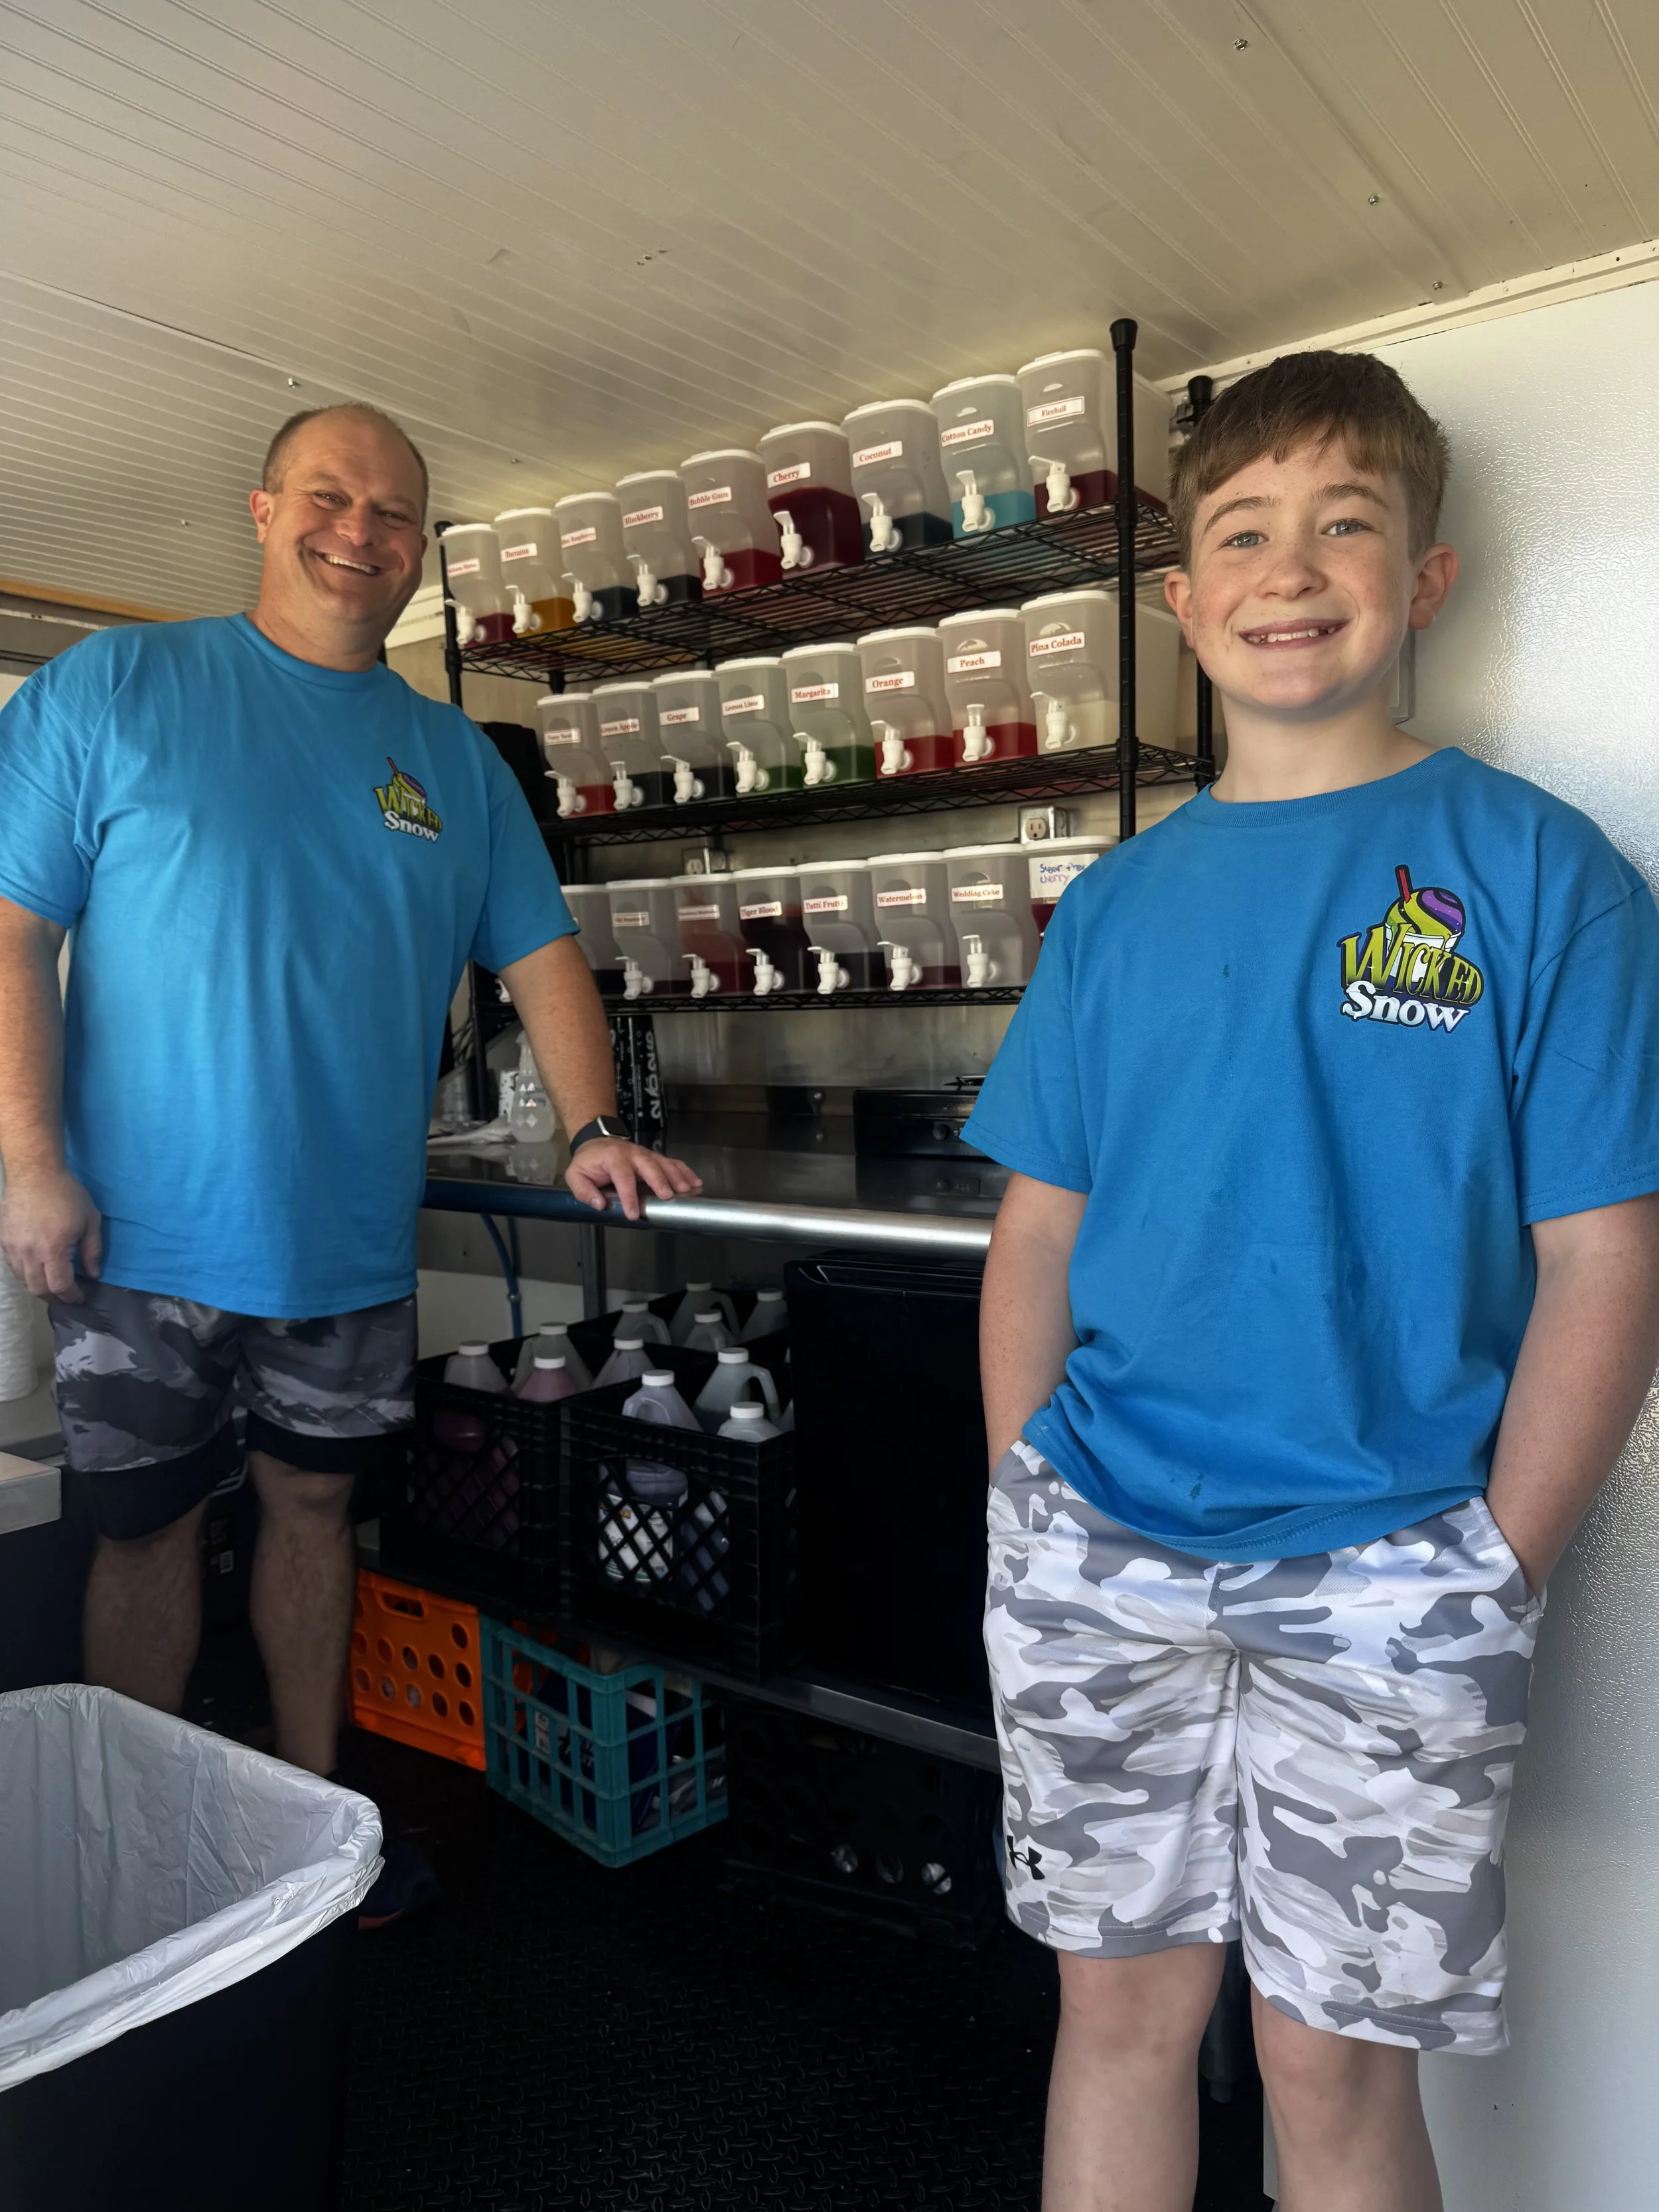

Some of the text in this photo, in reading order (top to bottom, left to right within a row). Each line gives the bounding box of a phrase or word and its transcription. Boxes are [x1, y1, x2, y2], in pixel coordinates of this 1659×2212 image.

[942, 424, 992, 443] Cotton Candy
[859, 448, 892, 463] Coconut
[772, 469, 800, 483] Cherry
[689, 491, 729, 506] Bubble Gum
[625, 511, 659, 525] Blackberry
[1031, 636, 1082, 653] Pina Colada
[960, 656, 985, 668] Peach
[871, 678, 904, 689] Orange
[795, 688, 831, 700] Margarita
[667, 713, 687, 722] Grape
[384, 810, 439, 842] Snow
[822, 900, 844, 909] Frutti
[878, 893, 923, 903] Watermelon
[741, 905, 779, 917] Tiger Blood
[1340, 922, 1483, 1005] WICKED
[1342, 980, 1470, 1032] Snow
